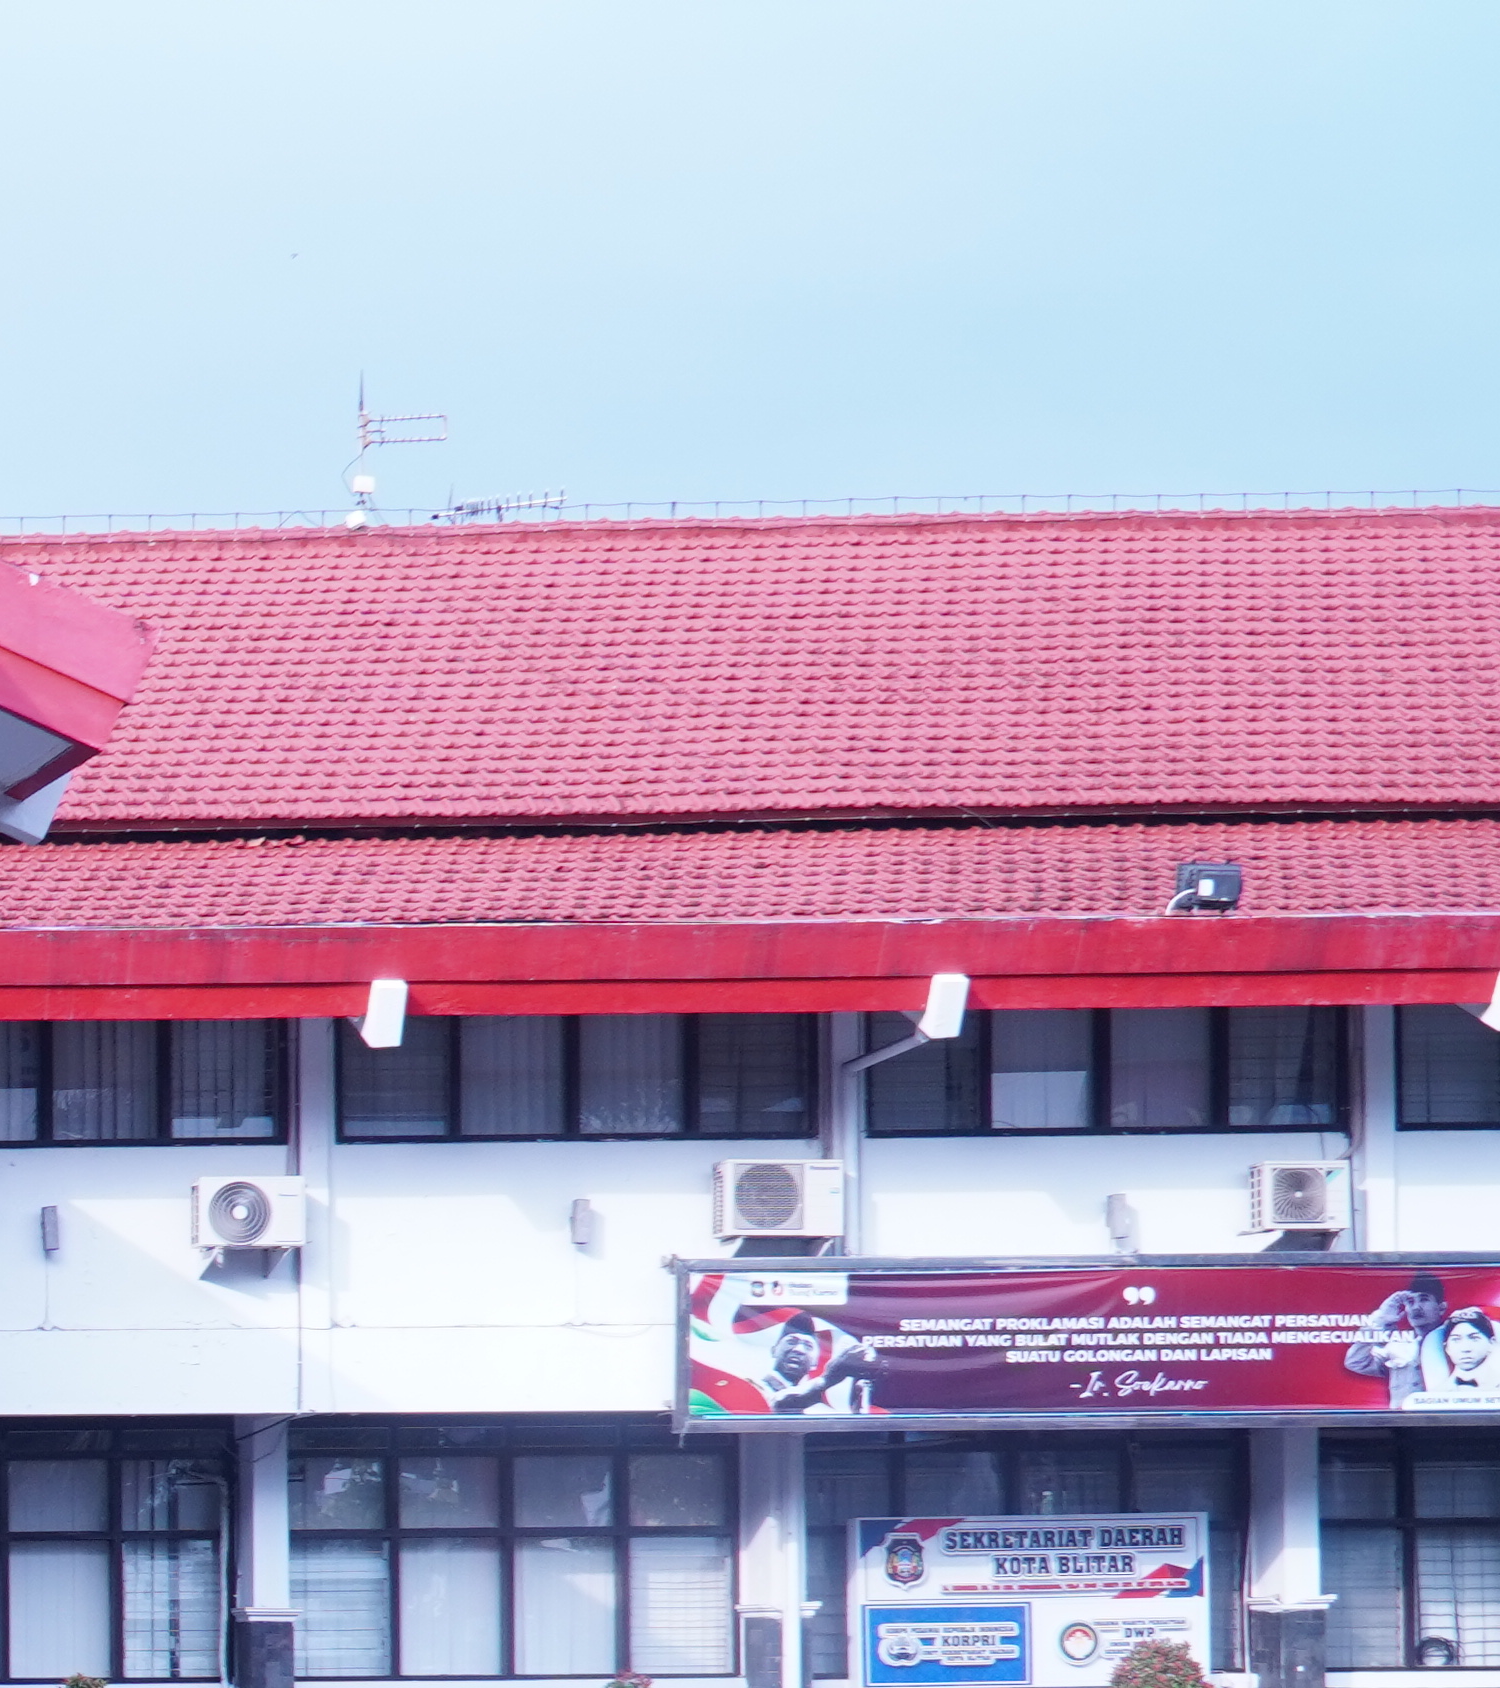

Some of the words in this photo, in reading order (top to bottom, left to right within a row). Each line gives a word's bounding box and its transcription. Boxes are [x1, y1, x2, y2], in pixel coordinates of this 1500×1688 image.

[899, 1318, 993, 1332] SEMANGAT
[996, 1317, 1104, 1331] PROKLAMASI
[1107, 1317, 1175, 1330] ADALAH
[1180, 1315, 1272, 1328] SEMANGAT
[862, 1335, 962, 1348] PERSATUAN
[965, 1334, 1012, 1347] YANG
[1015, 1334, 1068, 1346] BULAT
[1071, 1333, 1139, 1346] MUTLAK
[1143, 1332, 1214, 1345] DENGAN
[1217, 1331, 1269, 1344] TIADA
[1005, 1351, 1060, 1363] SUATU
[1063, 1350, 1156, 1363] GOLONGAN
[1160, 1350, 1196, 1362] DAN
[1200, 1348, 1273, 1361] LAPISAN
[944, 1530, 1092, 1550] SEKRETARIAT
[1099, 1527, 1183, 1548] DAERAH
[994, 1555, 1050, 1575] KOTA
[1058, 1553, 1134, 1574] BLITAR
[942, 1635, 996, 1647] KORPRI
[1124, 1627, 1155, 1638] DWP
